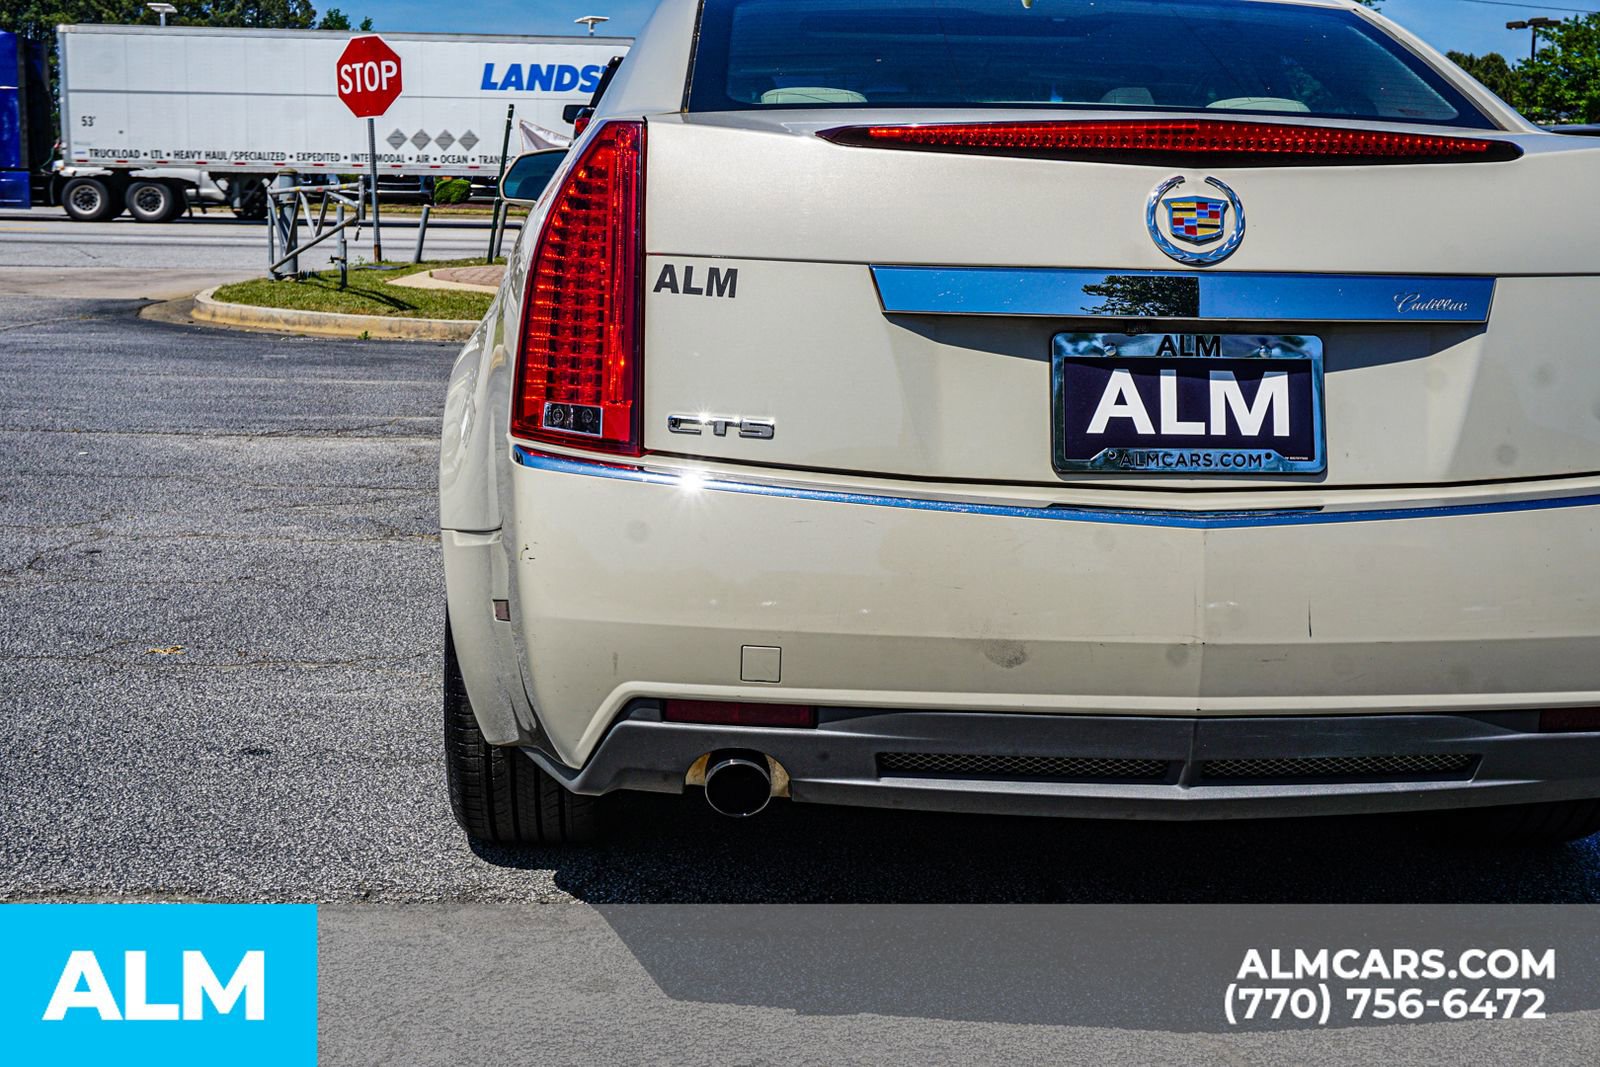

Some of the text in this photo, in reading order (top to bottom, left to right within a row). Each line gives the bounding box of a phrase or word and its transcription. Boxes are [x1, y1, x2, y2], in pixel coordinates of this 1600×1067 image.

[340, 60, 397, 94] STOP
[480, 63, 607, 93] LANDS
[89, 149, 140, 159] TRUCKLOAD
[151, 150, 164, 159] LTL
[174, 151, 201, 160] HEAVY
[296, 152, 341, 162] EXPEDITED
[351, 153, 405, 163] INTEMODAL
[416, 154, 431, 164] AIR
[440, 154, 468, 164] OCEAN
[653, 264, 738, 298] ALM
[1393, 293, 1468, 313] Cadillac
[1155, 335, 1222, 357] ALM
[1086, 368, 1290, 437] ALM
[667, 414, 775, 440] CTS
[1119, 452, 1263, 469] ALMCARS.COM
